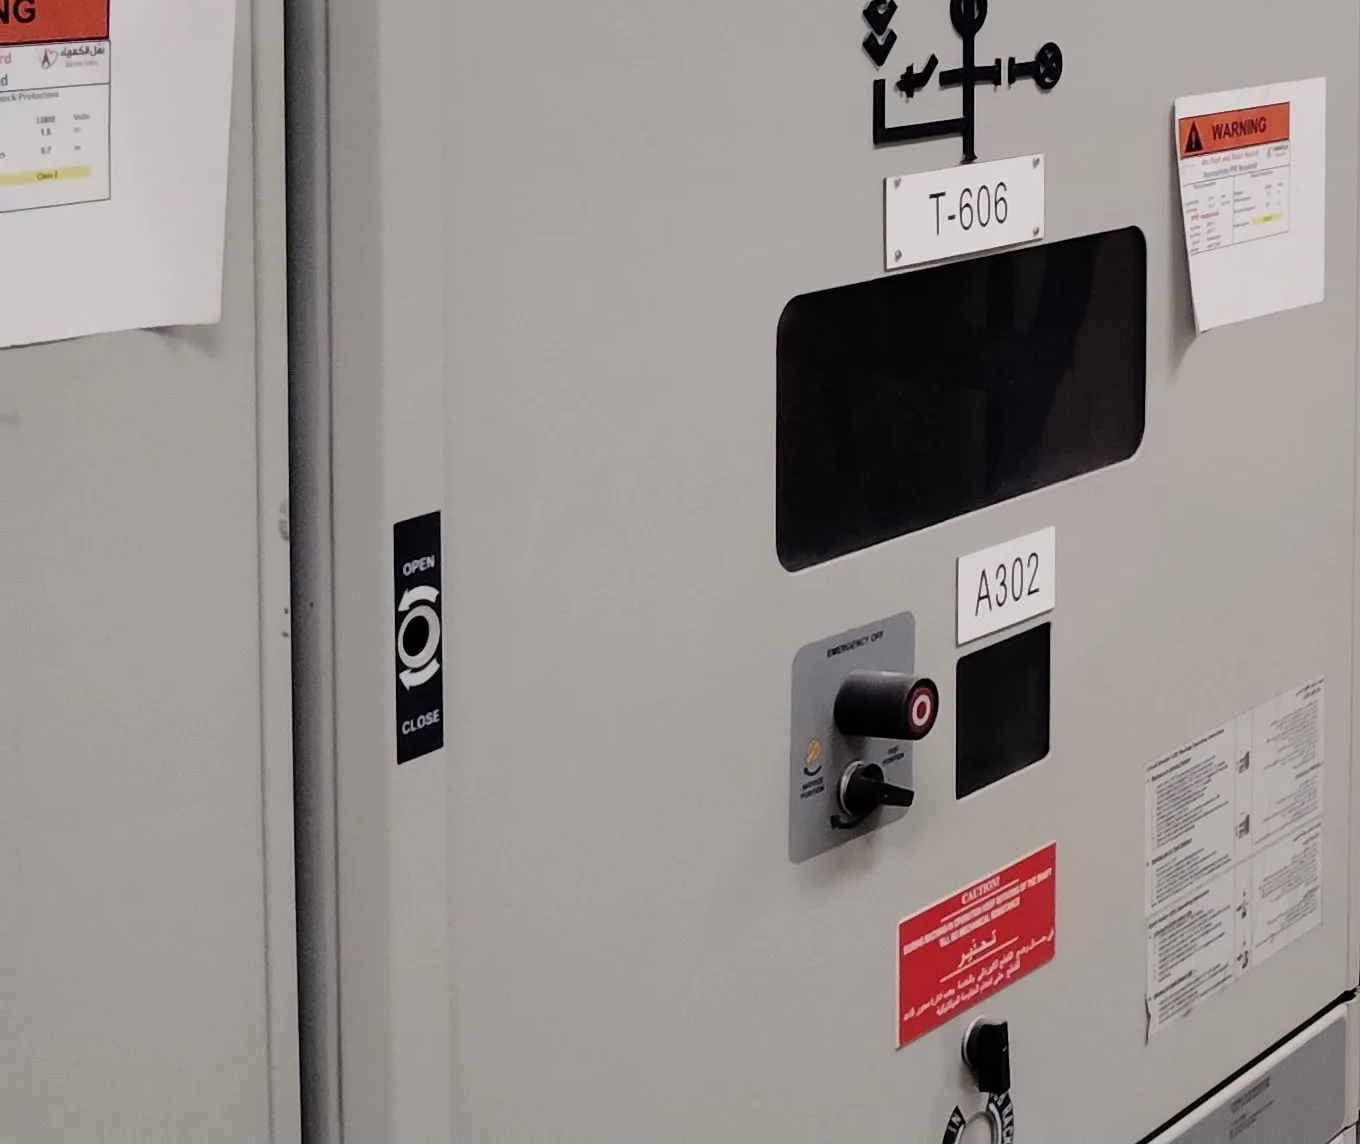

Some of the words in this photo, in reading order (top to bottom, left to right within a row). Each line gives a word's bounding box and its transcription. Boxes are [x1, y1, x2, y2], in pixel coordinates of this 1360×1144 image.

[1211, 116, 1267, 141] WARNING
[929, 181, 1008, 236] T-606
[402, 555, 436, 577] OPEN
[975, 551, 1040, 617] A302
[826, 635, 869, 658] EMERGENCY
[402, 708, 440, 735] CLOSE
